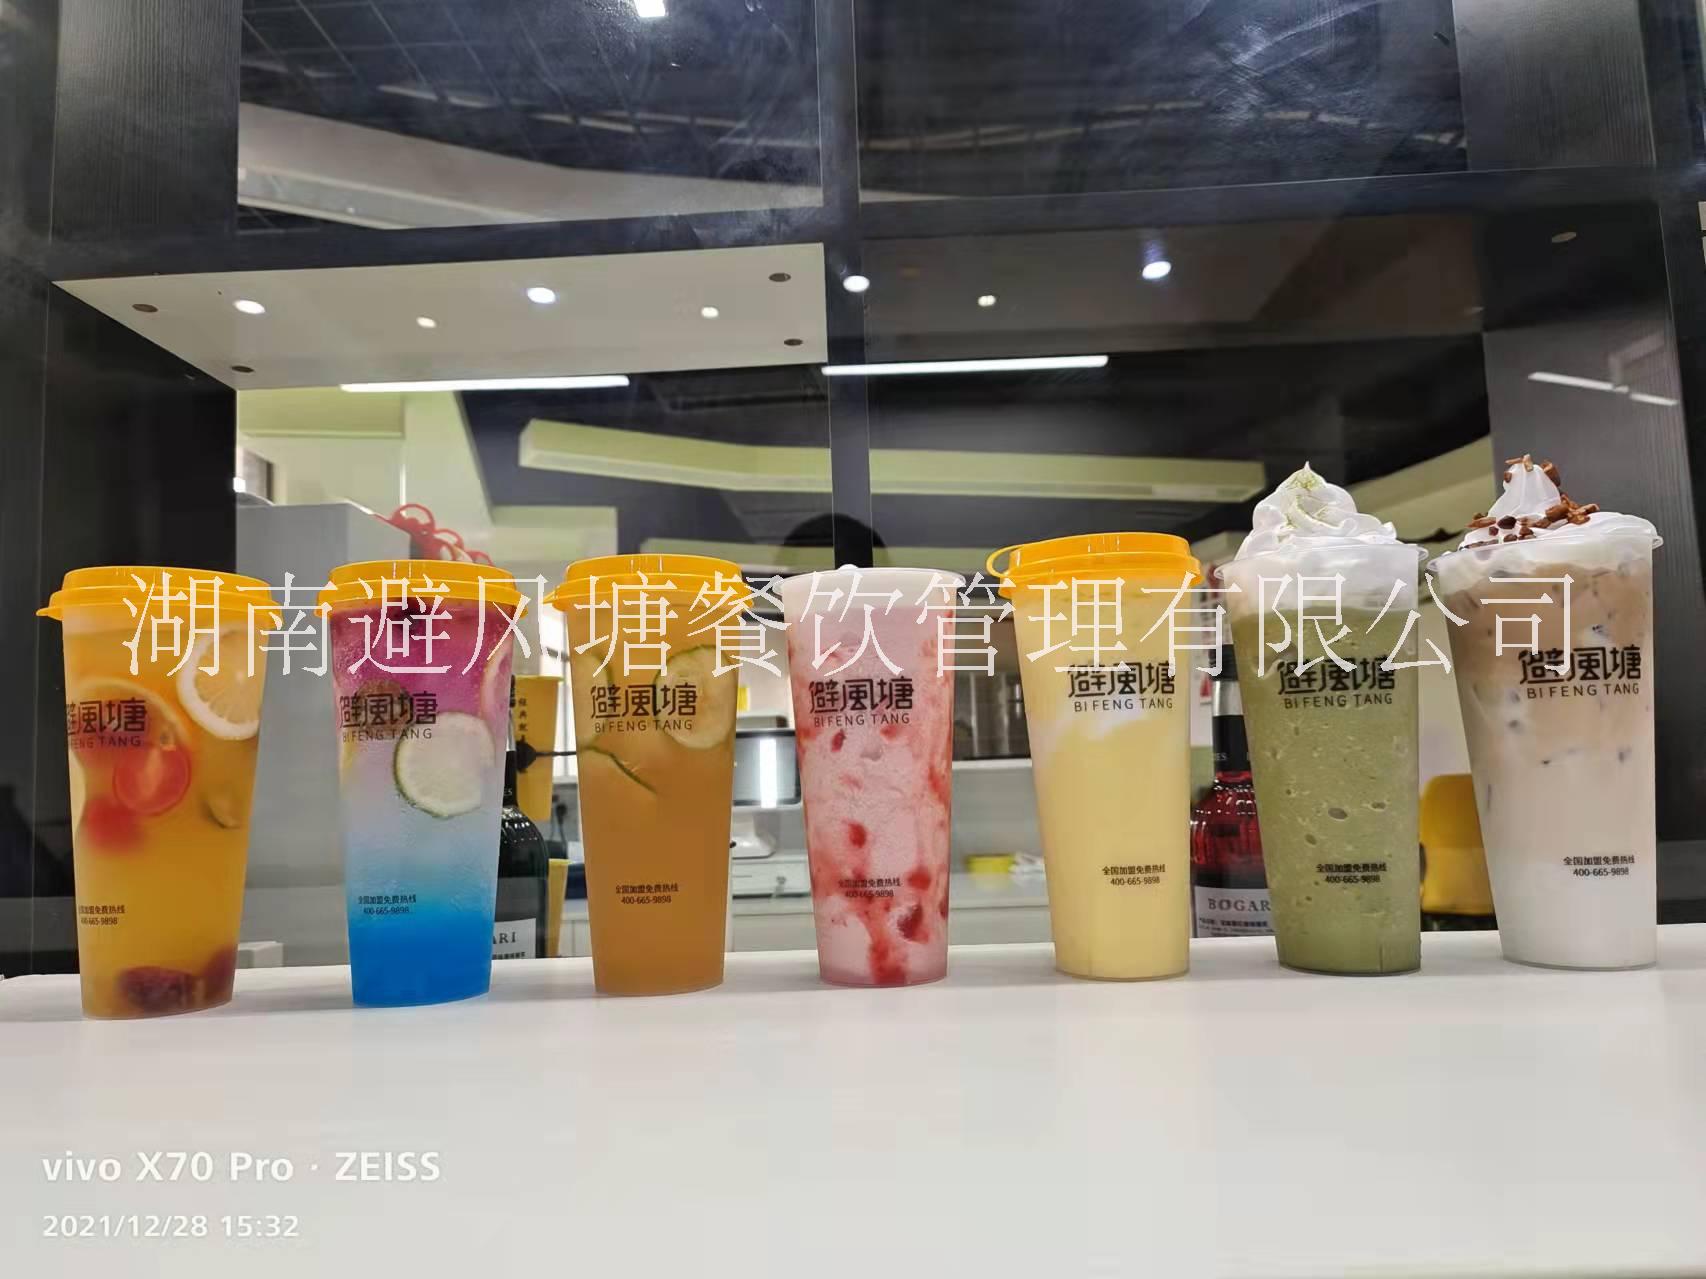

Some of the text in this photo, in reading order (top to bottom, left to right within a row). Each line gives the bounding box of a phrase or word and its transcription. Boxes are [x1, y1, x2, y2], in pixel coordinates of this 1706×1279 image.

[1604, 682, 1640, 695] TANG
[1139, 698, 1173, 710] TANG
[1354, 692, 1393, 707] TANG
[871, 712, 910, 724] TANG
[654, 719, 693, 731] TANG
[391, 728, 432, 740] TANG
[98, 735, 141, 748] TANG
[1563, 854, 1636, 866] 全国加盟免费热线
[1102, 863, 1166, 875] 全国加盟免费热线
[1573, 867, 1630, 877] 400-665-9898
[1110, 876, 1161, 886] 400-665-9898
[621, 895, 672, 905] 400-665-9898
